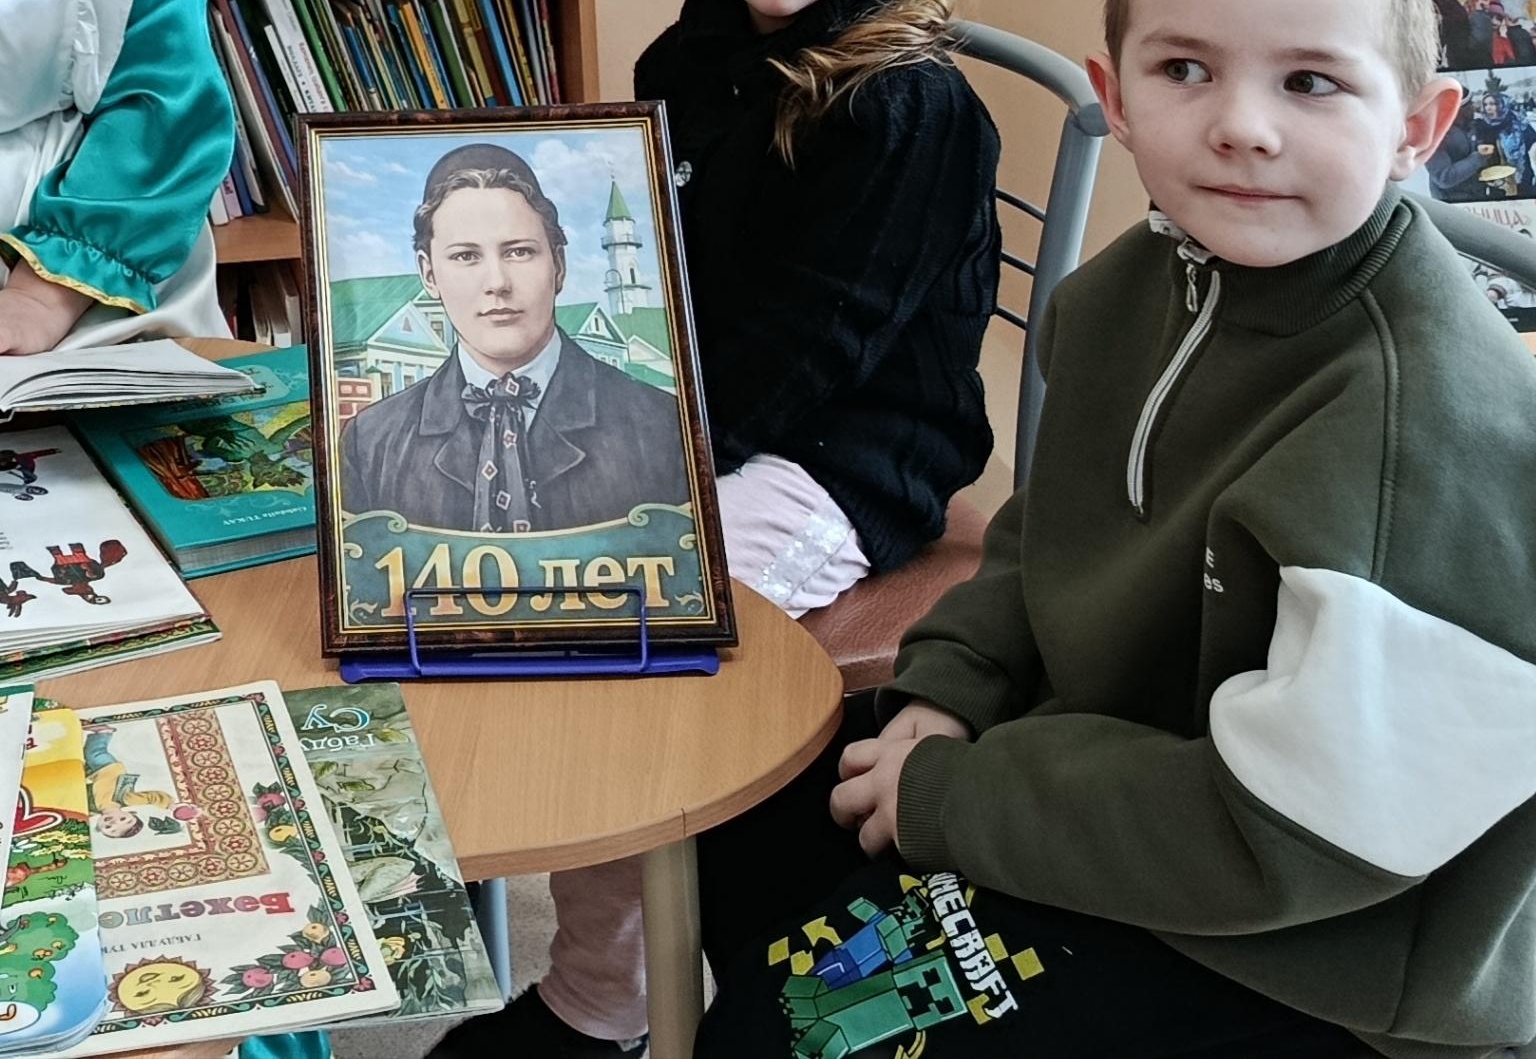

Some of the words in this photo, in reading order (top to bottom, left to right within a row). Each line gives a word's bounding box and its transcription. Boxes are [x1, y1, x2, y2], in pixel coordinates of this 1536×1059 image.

[374, 543, 519, 618] 140
[535, 554, 675, 609] лет
[300, 704, 370, 733] Су
[129, 932, 201, 951] ГАБДУЛЛА
